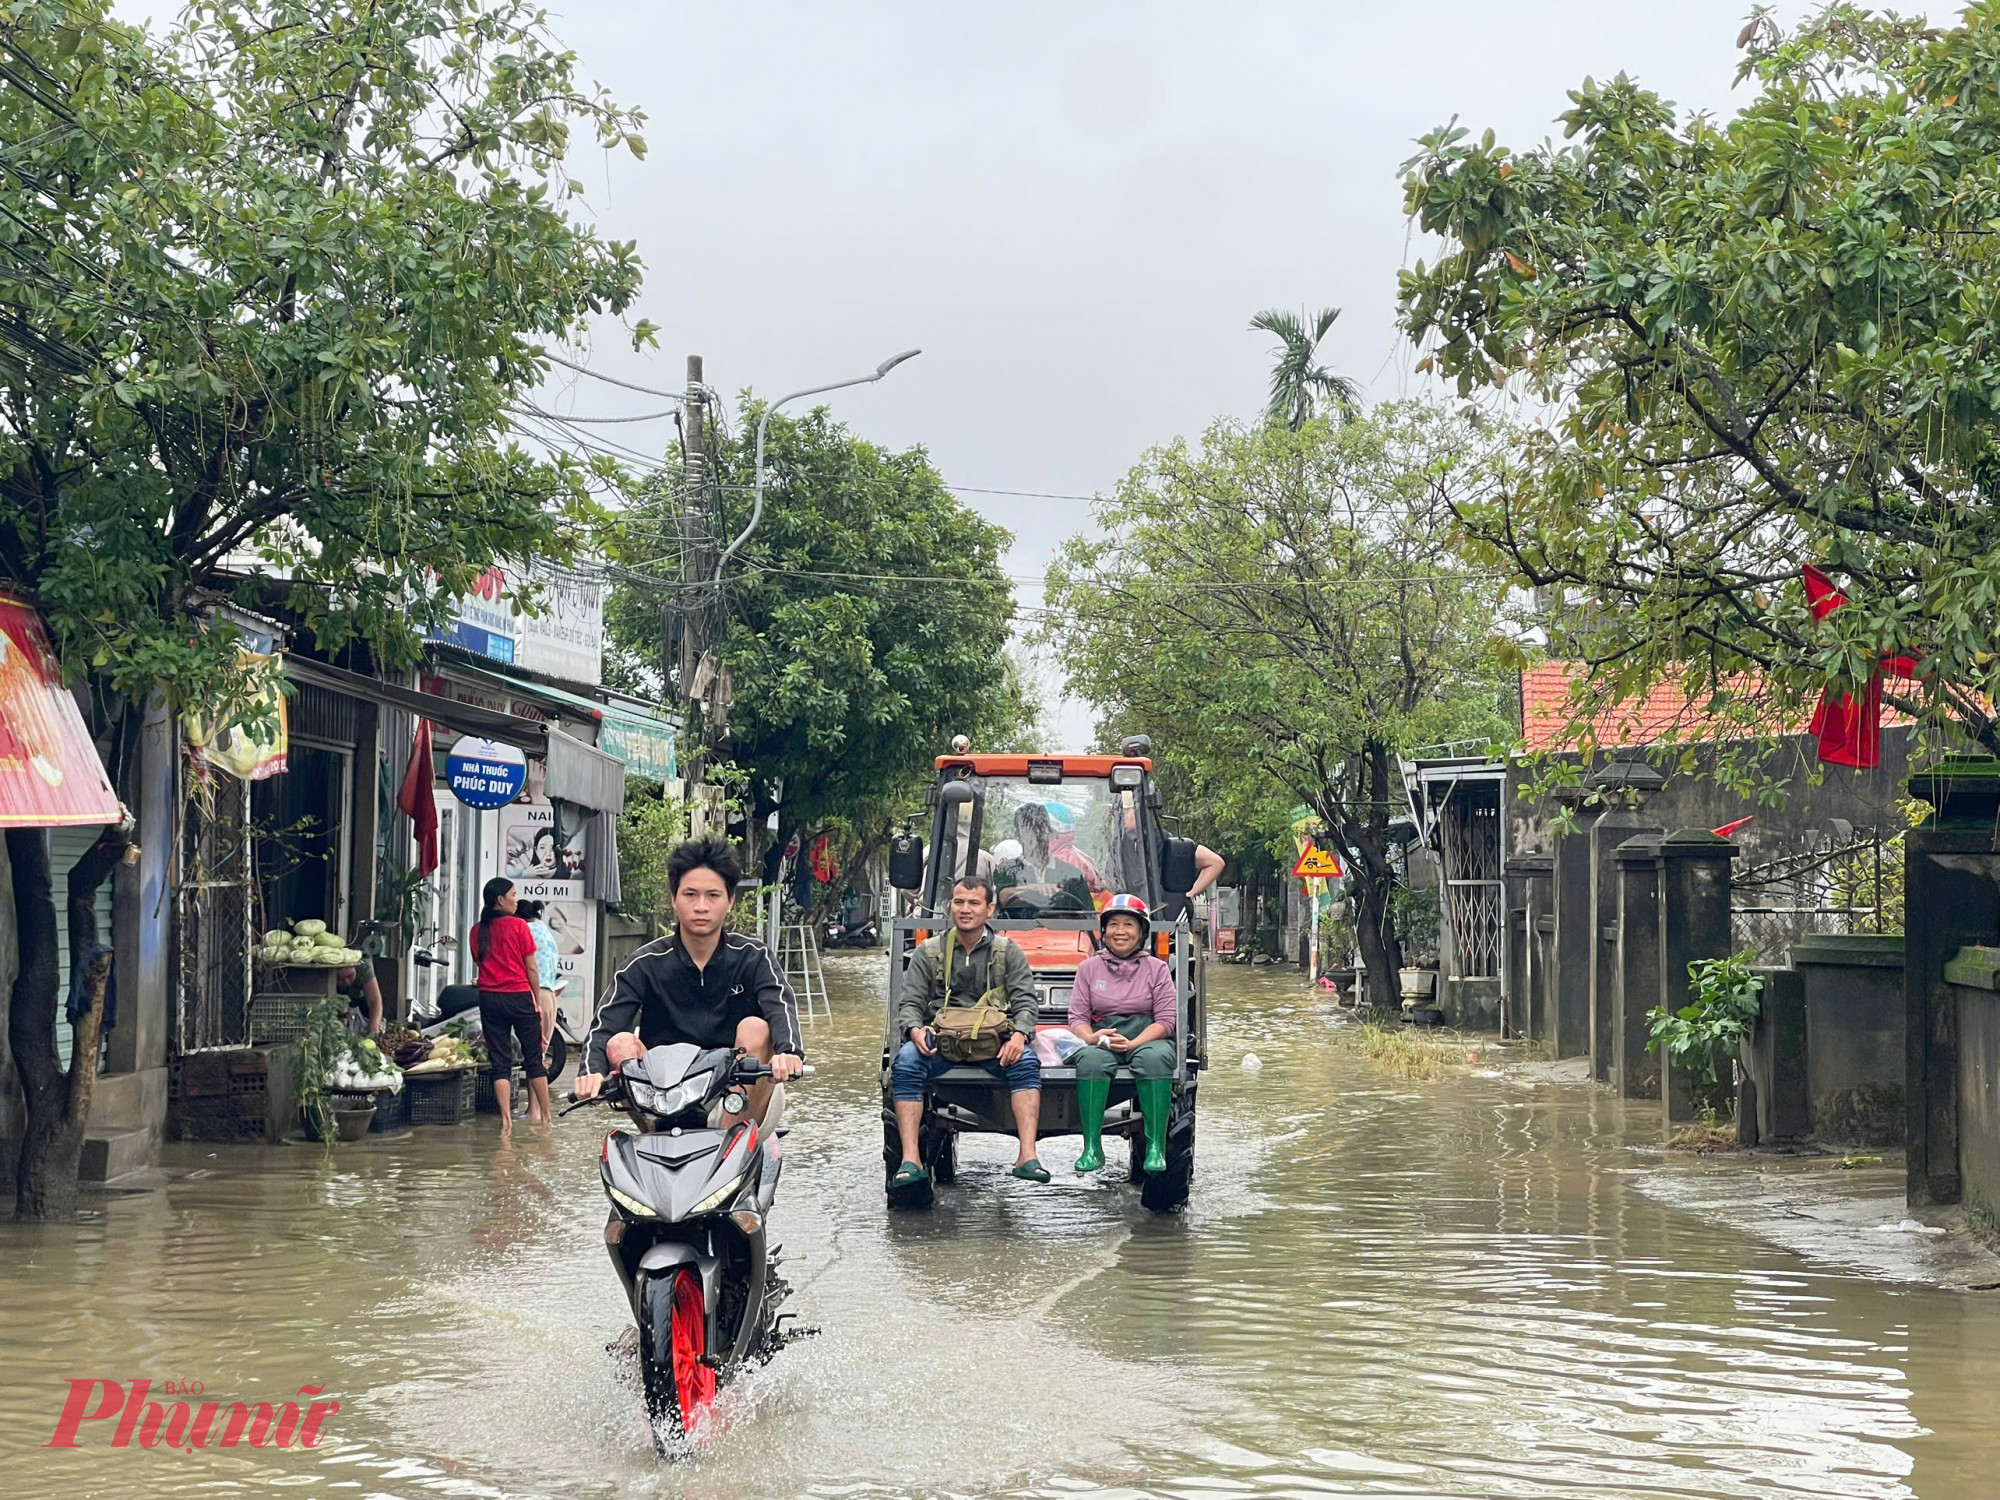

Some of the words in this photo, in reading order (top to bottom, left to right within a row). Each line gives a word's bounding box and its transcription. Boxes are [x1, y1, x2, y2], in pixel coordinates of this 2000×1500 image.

[462, 762, 480, 774] NHÀ
[482, 764, 509, 777] THUỐC
[453, 775, 486, 792] PHÚC
[488, 780, 514, 795] DUY
[528, 811, 552, 821] NAI
[524, 882, 548, 896] NỐI
[553, 886, 569, 896] MI
